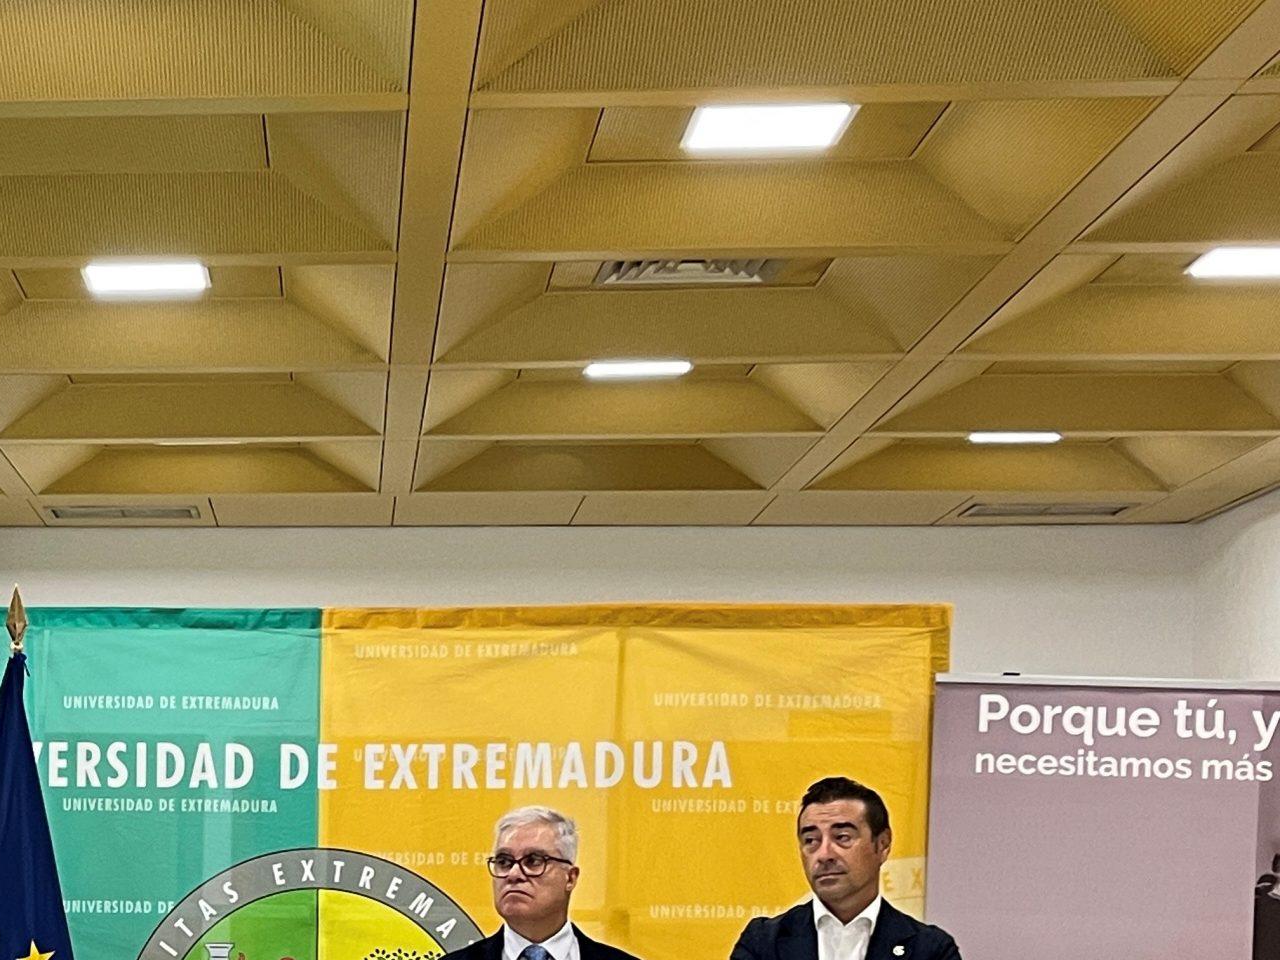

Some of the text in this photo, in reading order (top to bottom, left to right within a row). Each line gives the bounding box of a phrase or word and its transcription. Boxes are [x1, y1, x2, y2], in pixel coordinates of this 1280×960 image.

[355, 643, 578, 658] UNIVERSIDAD DE EXTREMADURA
[63, 695, 279, 710] UNIVERSIDAD DE EXTREMADURA
[654, 693, 882, 708] UNIVERSIDAD DE EXTREMADURA
[978, 693, 1161, 746] Porque
[1173, 698, 1237, 745] tú,
[279, 743, 338, 790] DE
[364, 741, 733, 790] EXTREMADURA
[975, 748, 1273, 782] necesitamos más
[63, 798, 278, 813] UNIVERSIDAD DE EXTREMADURA
[652, 799, 745, 813] UNIVERSIDAD
[753, 800, 769, 813] DE
[451, 852, 468, 865] DE
[650, 905, 745, 918] UNIVERSIDAD
